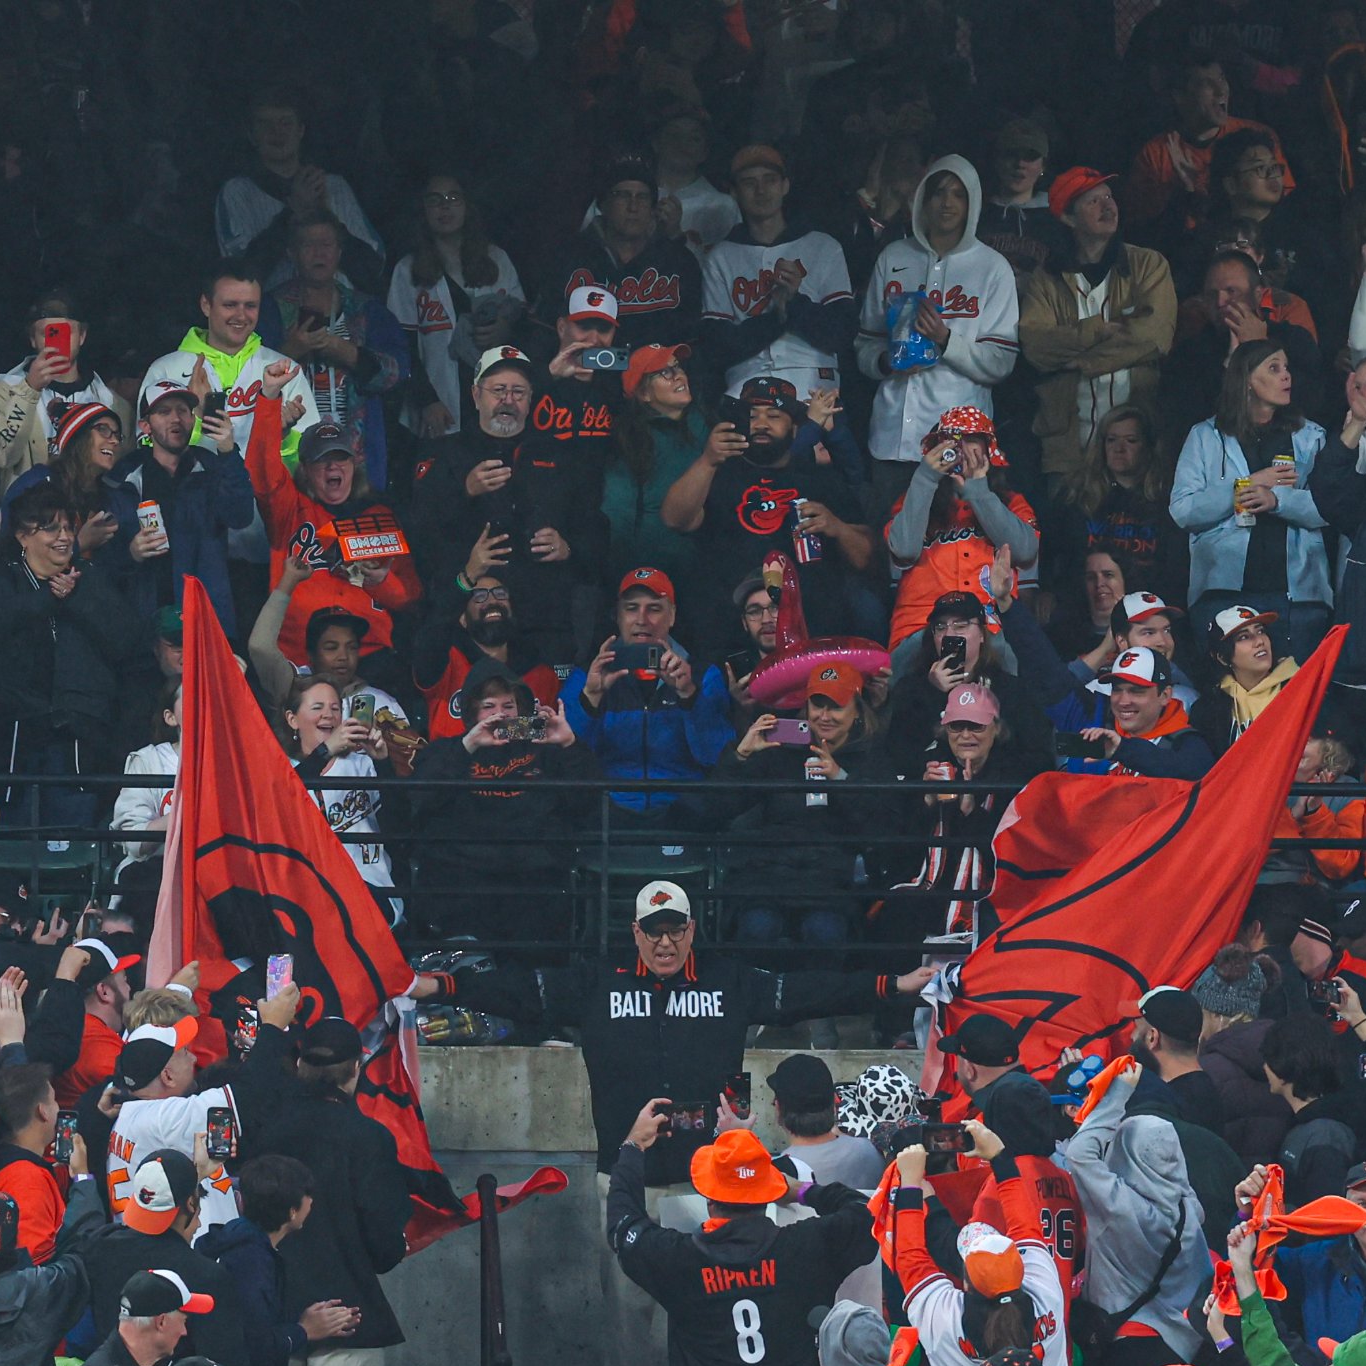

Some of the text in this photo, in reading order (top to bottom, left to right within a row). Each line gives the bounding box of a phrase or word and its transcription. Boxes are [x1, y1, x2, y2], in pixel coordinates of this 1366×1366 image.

[348, 534, 398, 550] BMORE
[350, 545, 401, 558] CHICKEN BOX
[1040, 1208, 1076, 1261] 26
[701, 1258, 776, 1295] RIPKEN
[731, 1298, 766, 1364] 8
